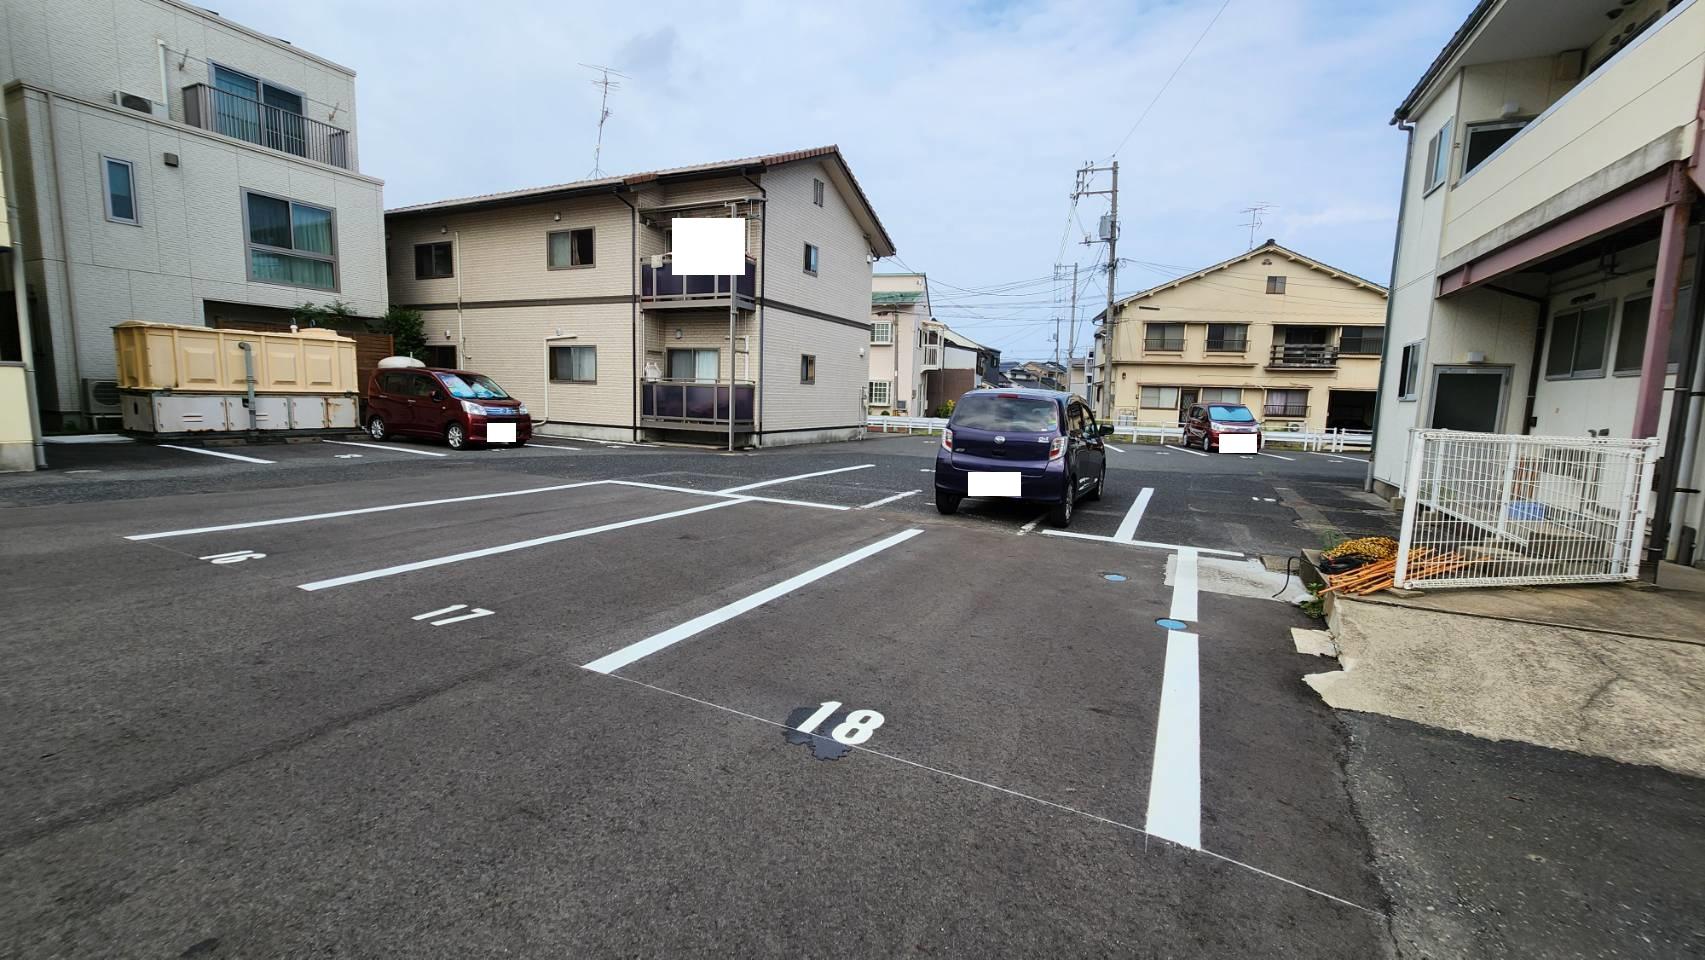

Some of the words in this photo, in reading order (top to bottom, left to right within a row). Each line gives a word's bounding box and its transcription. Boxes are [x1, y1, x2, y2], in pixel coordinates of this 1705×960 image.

[198, 550, 267, 564] 16
[411, 604, 495, 627] 17
[796, 700, 885, 745] 18
